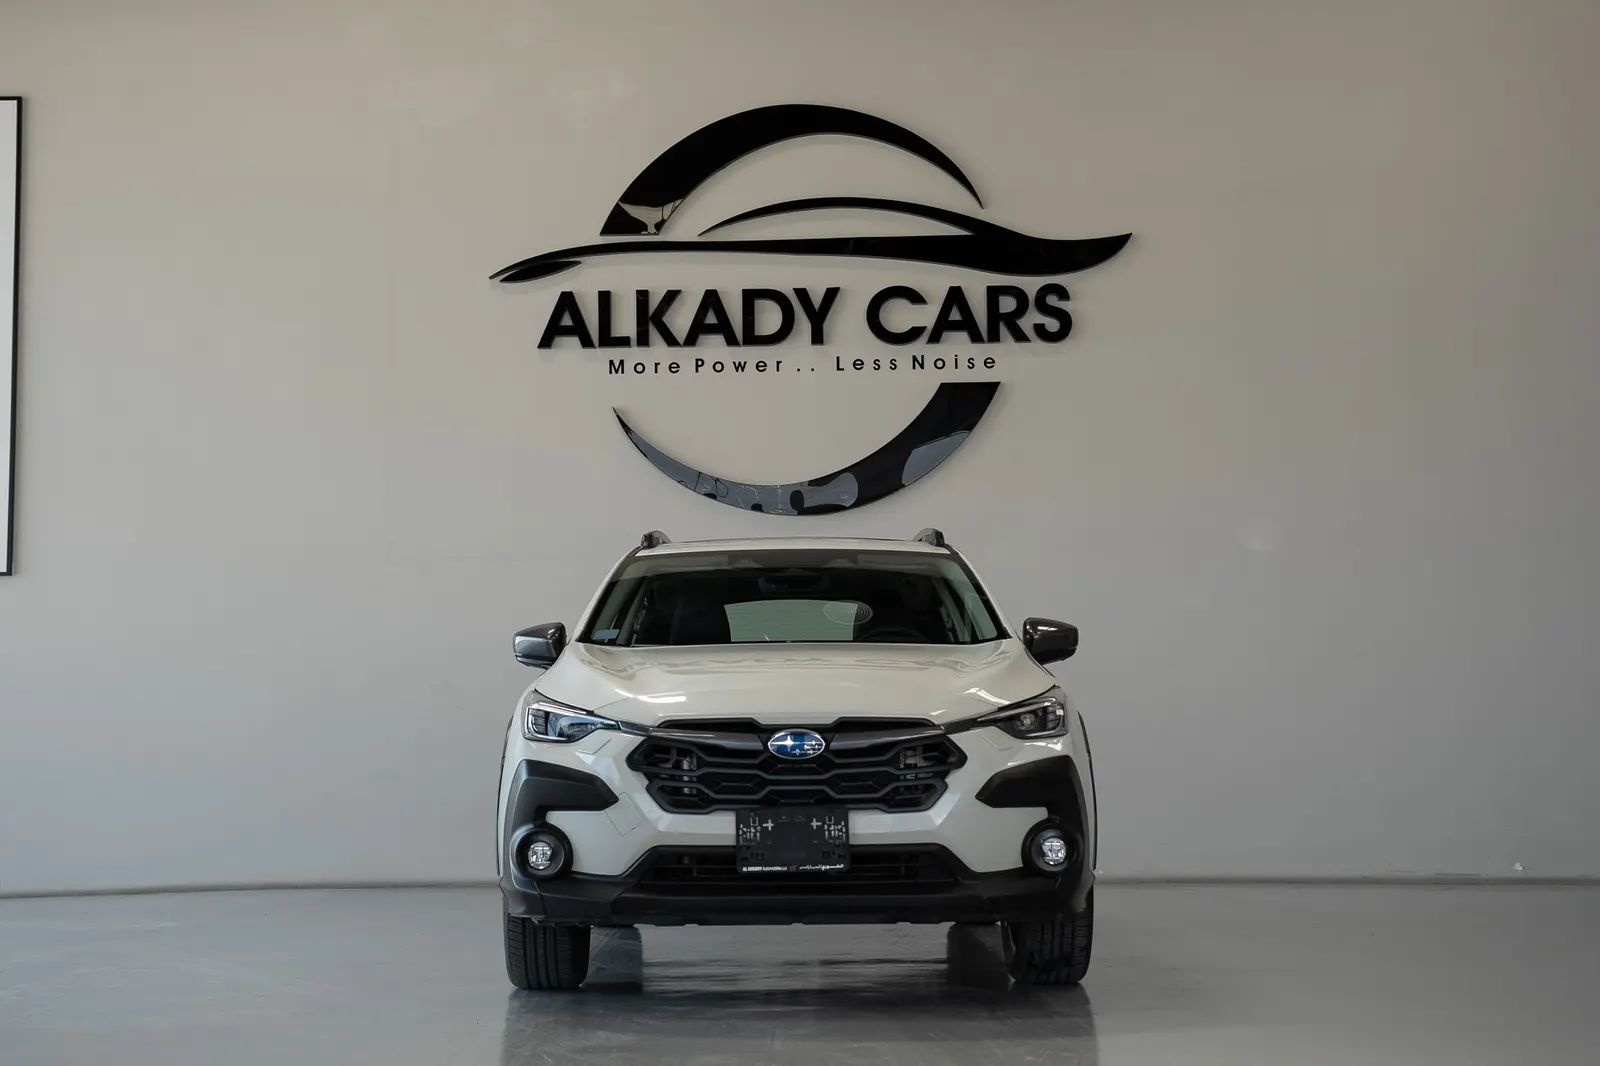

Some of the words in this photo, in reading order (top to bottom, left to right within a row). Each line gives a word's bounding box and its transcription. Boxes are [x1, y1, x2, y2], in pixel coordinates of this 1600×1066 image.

[537, 286, 841, 350] ALKADY
[865, 283, 1073, 347] CARS
[608, 357, 681, 375] More
[694, 356, 783, 374] Power
[836, 355, 898, 371] Less
[911, 354, 996, 371] Noise
